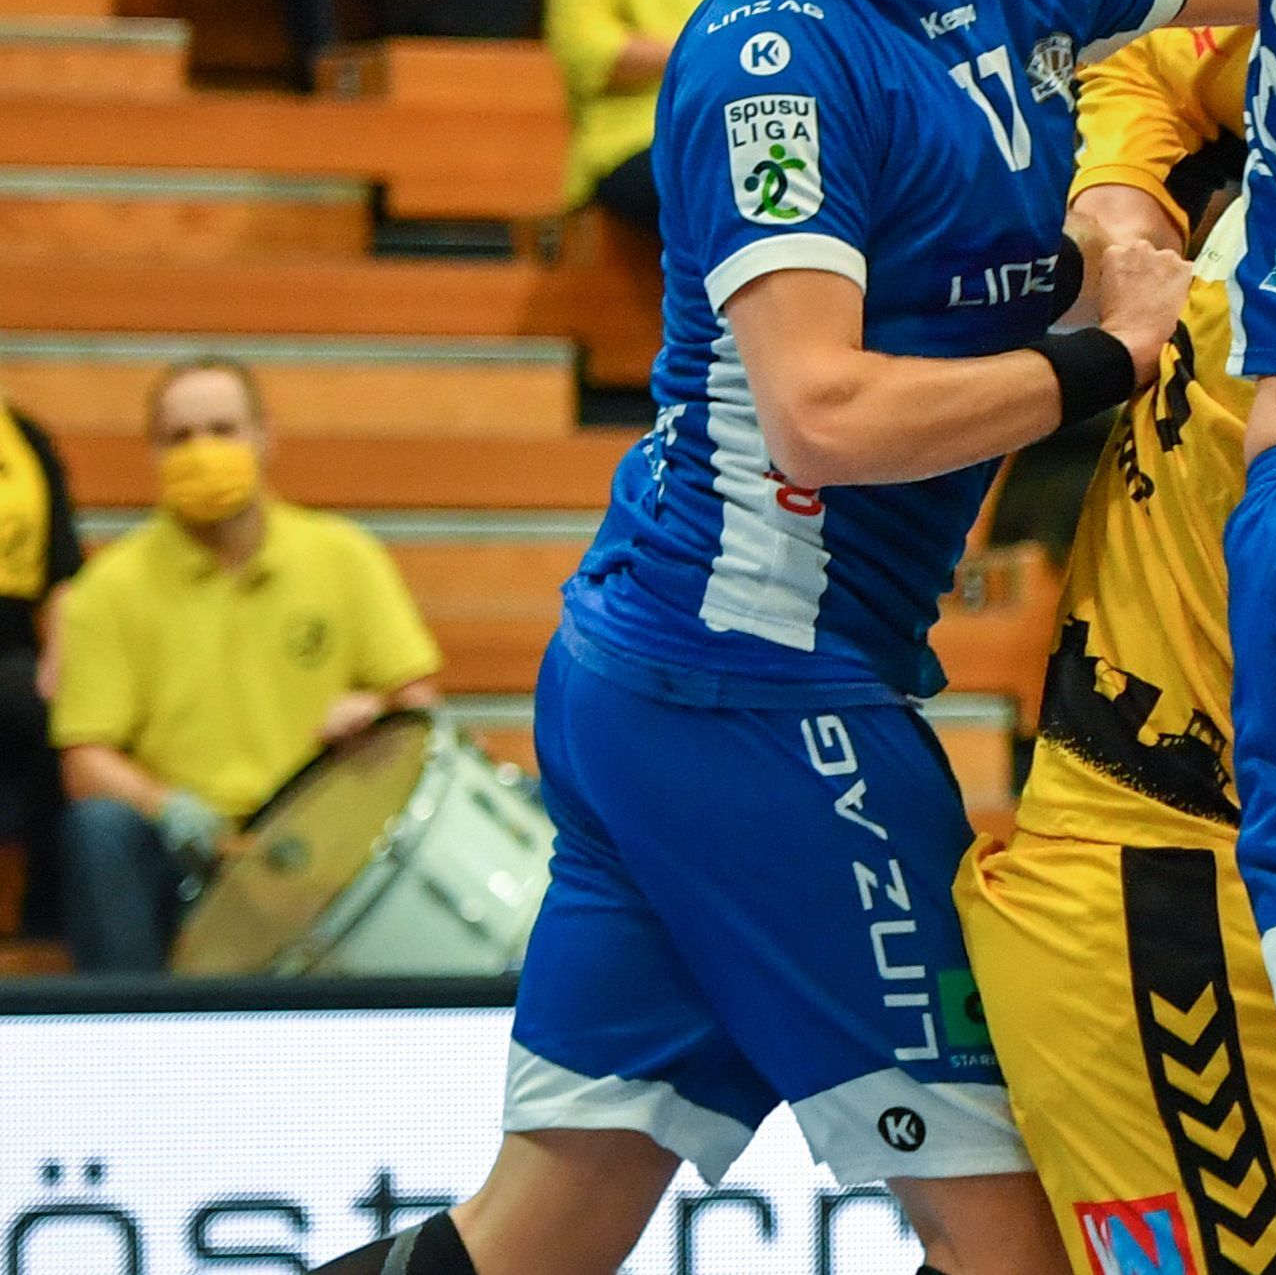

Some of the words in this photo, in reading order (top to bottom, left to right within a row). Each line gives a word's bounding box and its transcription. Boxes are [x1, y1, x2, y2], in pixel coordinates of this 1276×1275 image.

[728, 99, 810, 124] spusu
[731, 120, 811, 149] LIGA
[947, 44, 1032, 172] 17
[800, 713, 890, 842] AG
[853, 858, 940, 1062] LINZ
